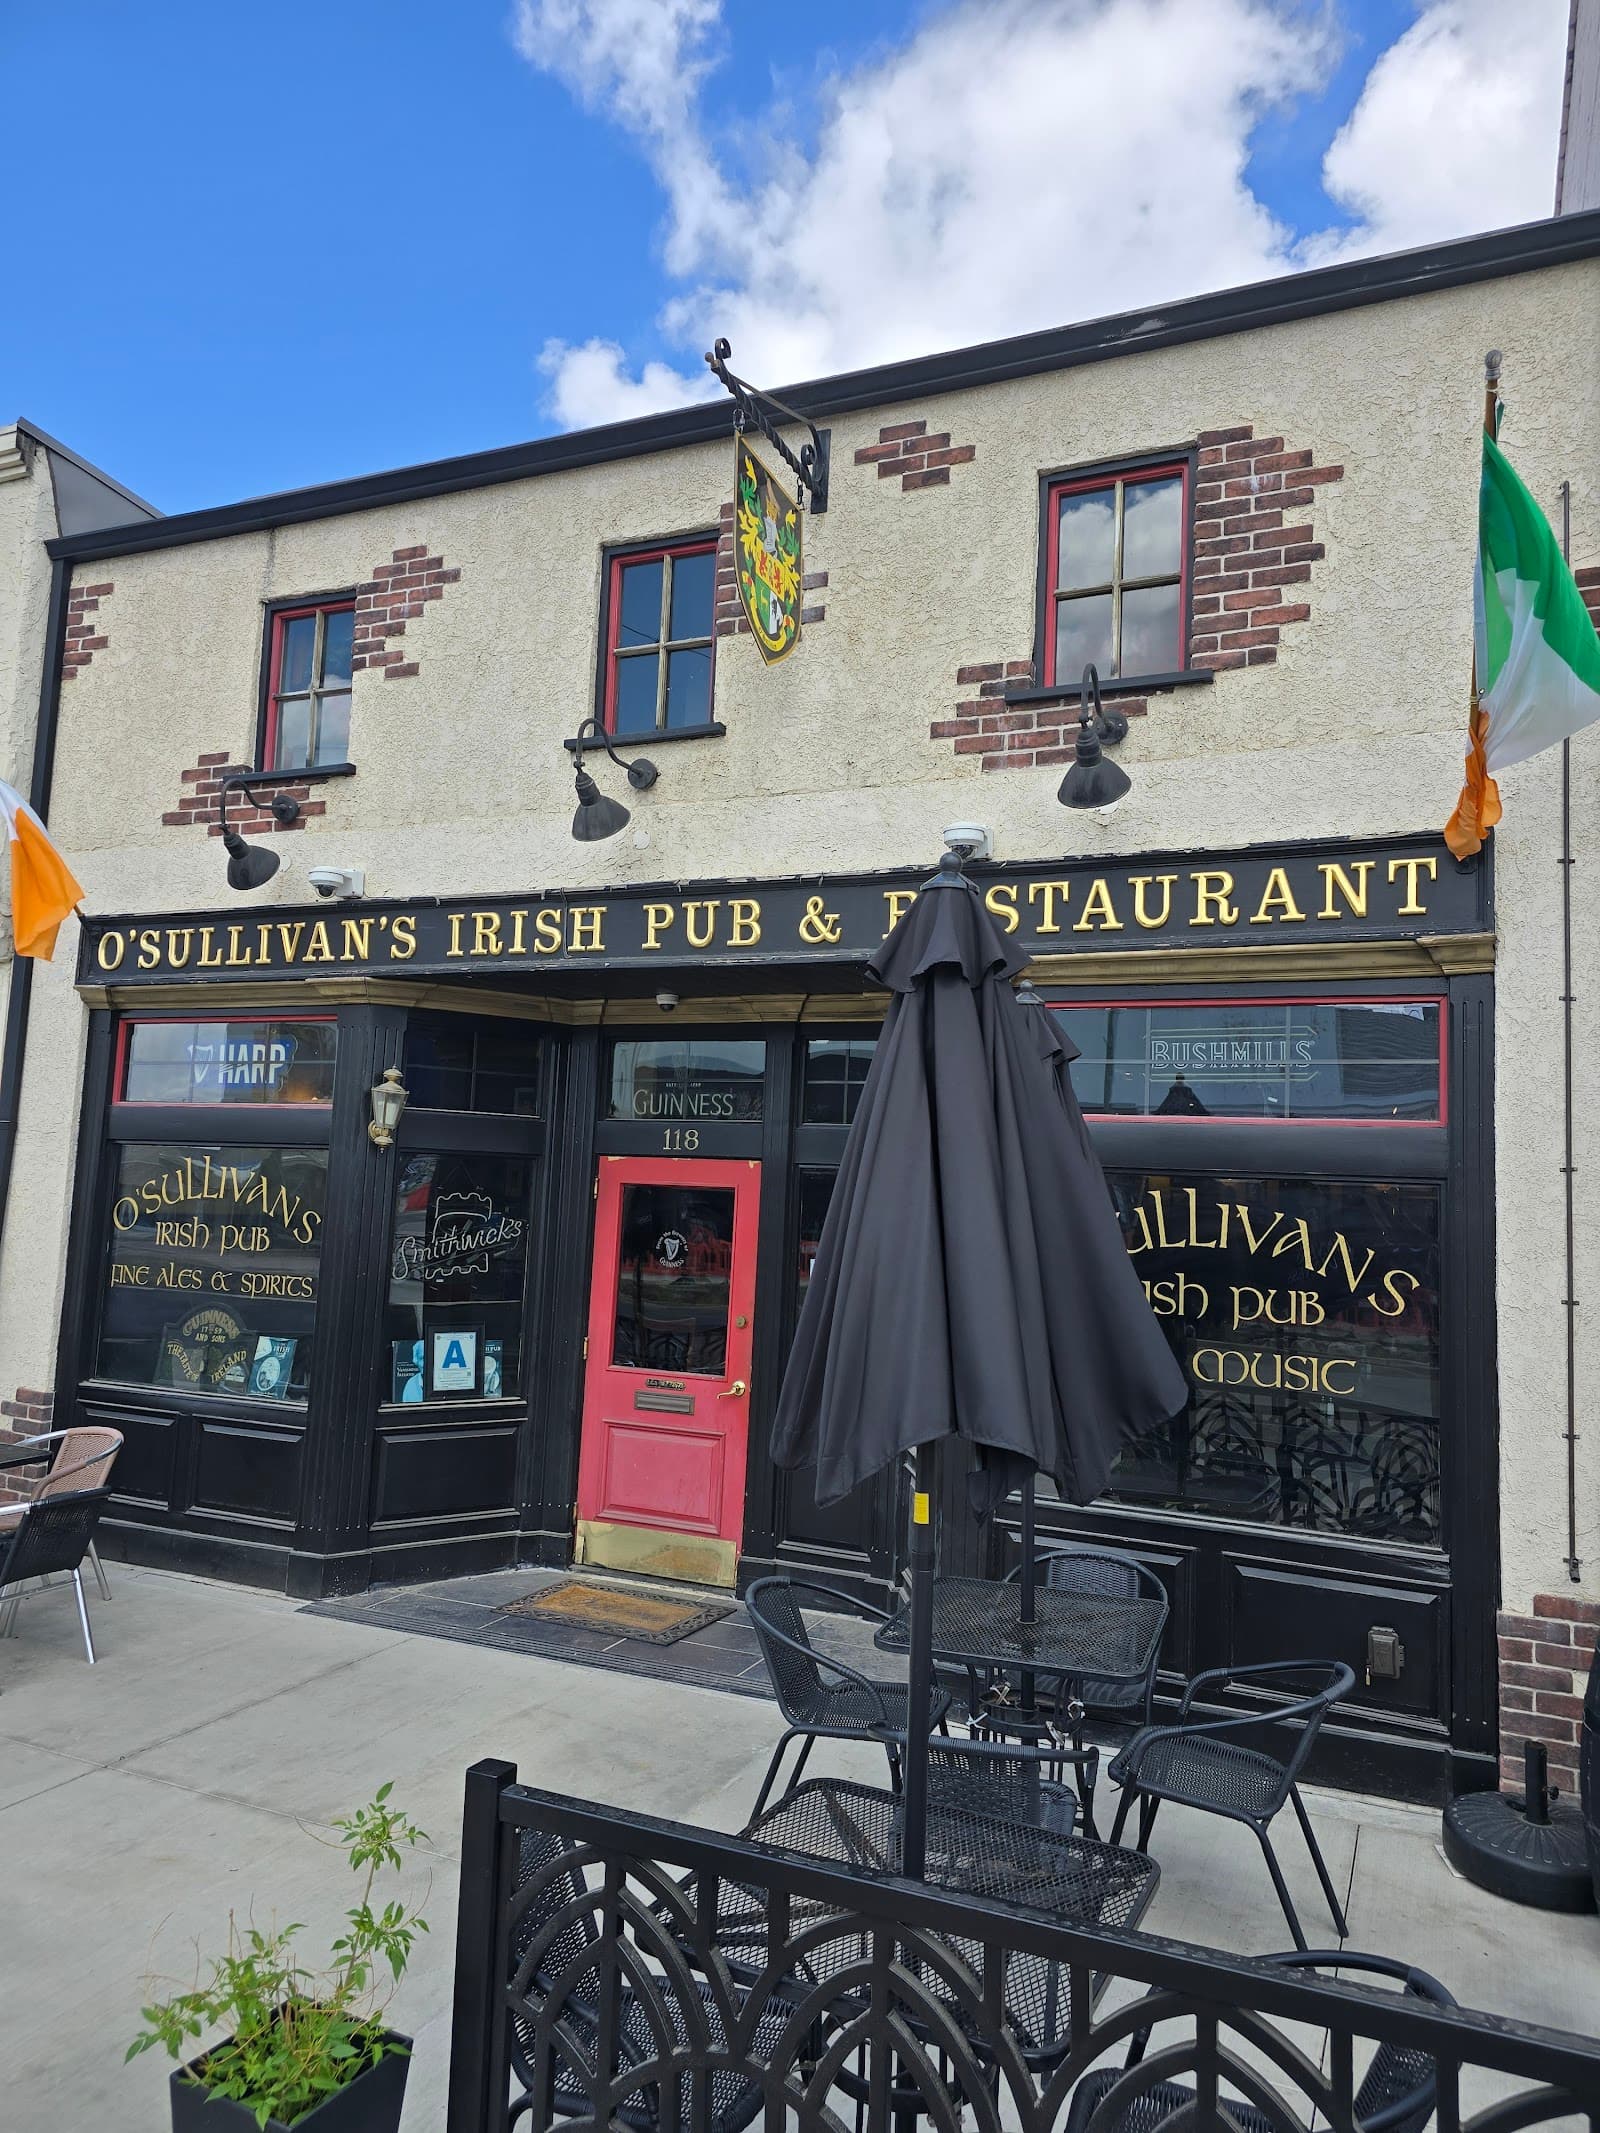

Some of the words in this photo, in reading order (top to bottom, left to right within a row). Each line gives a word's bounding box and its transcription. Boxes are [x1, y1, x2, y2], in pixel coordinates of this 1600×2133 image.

[98, 916, 418, 971] O'SULLIVAN'S
[446, 906, 609, 958] IRISH
[642, 897, 763, 950] PUB
[798, 895, 844, 944] &
[881, 857, 1438, 940] RSTAURANT
[218, 1043, 287, 1084] HARP
[1151, 1040, 1313, 1069] BUSHMILLS
[633, 1088, 734, 1116] GUINNESS
[663, 1128, 699, 1151] 118
[112, 1155, 322, 1244] O'SULLIVANS
[111, 1264, 150, 1288] FINE
[156, 1262, 202, 1289] ALES
[211, 1271, 233, 1291] &
[240, 1272, 313, 1298] SPIRITS
[1229, 1286, 1326, 1331] PUB
[211, 1350, 247, 1384] IRELAND
[442, 1339, 467, 1369] A
[1192, 1348, 1357, 1394] MUSIC
